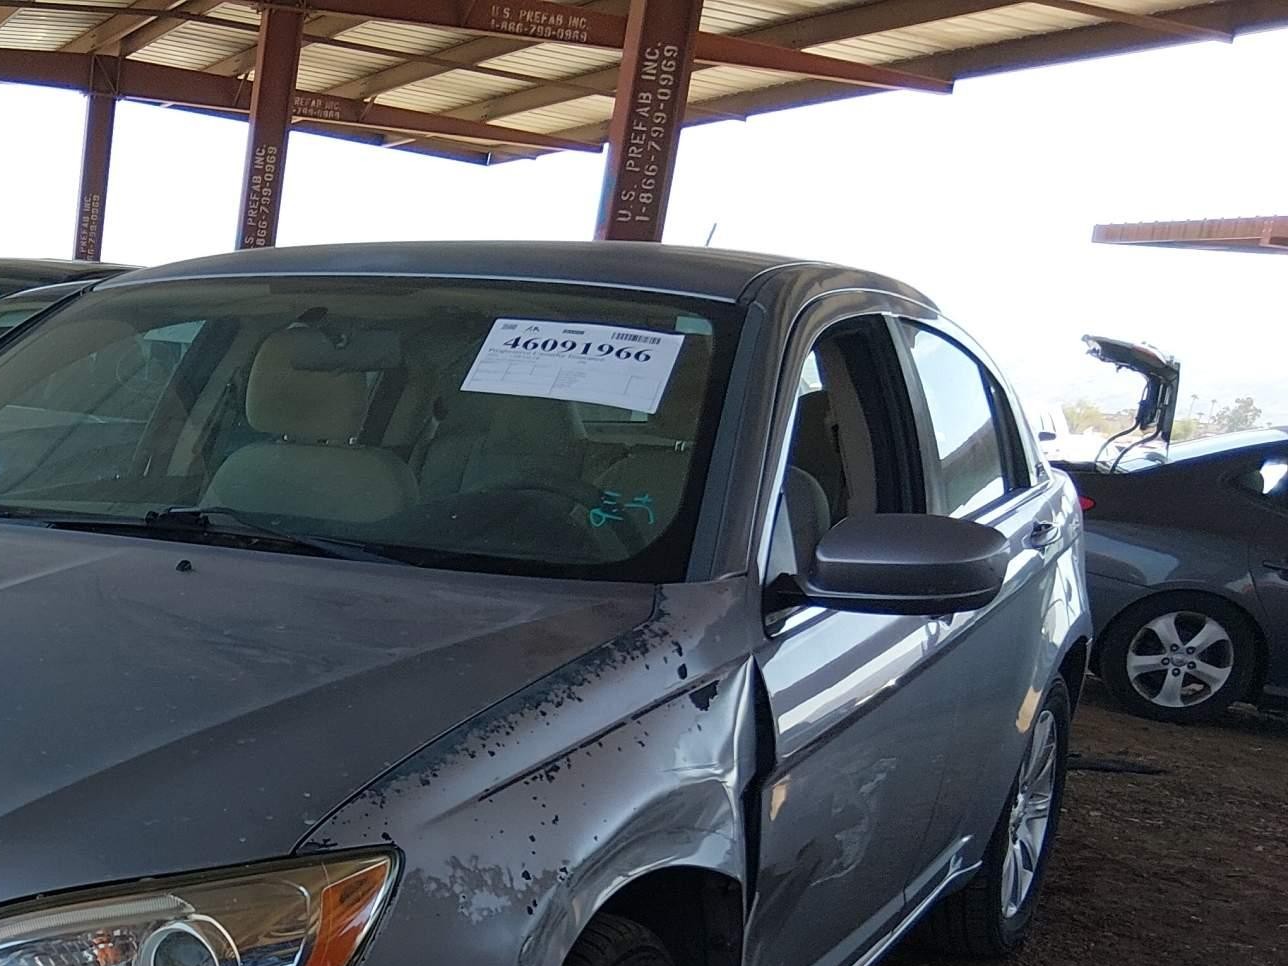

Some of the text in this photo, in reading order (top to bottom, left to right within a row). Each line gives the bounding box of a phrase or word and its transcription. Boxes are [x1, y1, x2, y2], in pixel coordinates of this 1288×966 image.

[491, 19, 588, 42] 1-866-799-0969
[519, 9, 563, 26] PREFAB
[568, 15, 590, 30] INC.
[616, 41, 662, 222] U.S. PREFAB INC.
[635, 45, 679, 221] 1-866-799-0969
[254, 144, 267, 169] INC.
[247, 175, 262, 226] PREFAB
[255, 145, 277, 247] 866-799-0969
[503, 336, 654, 362] 46091966
